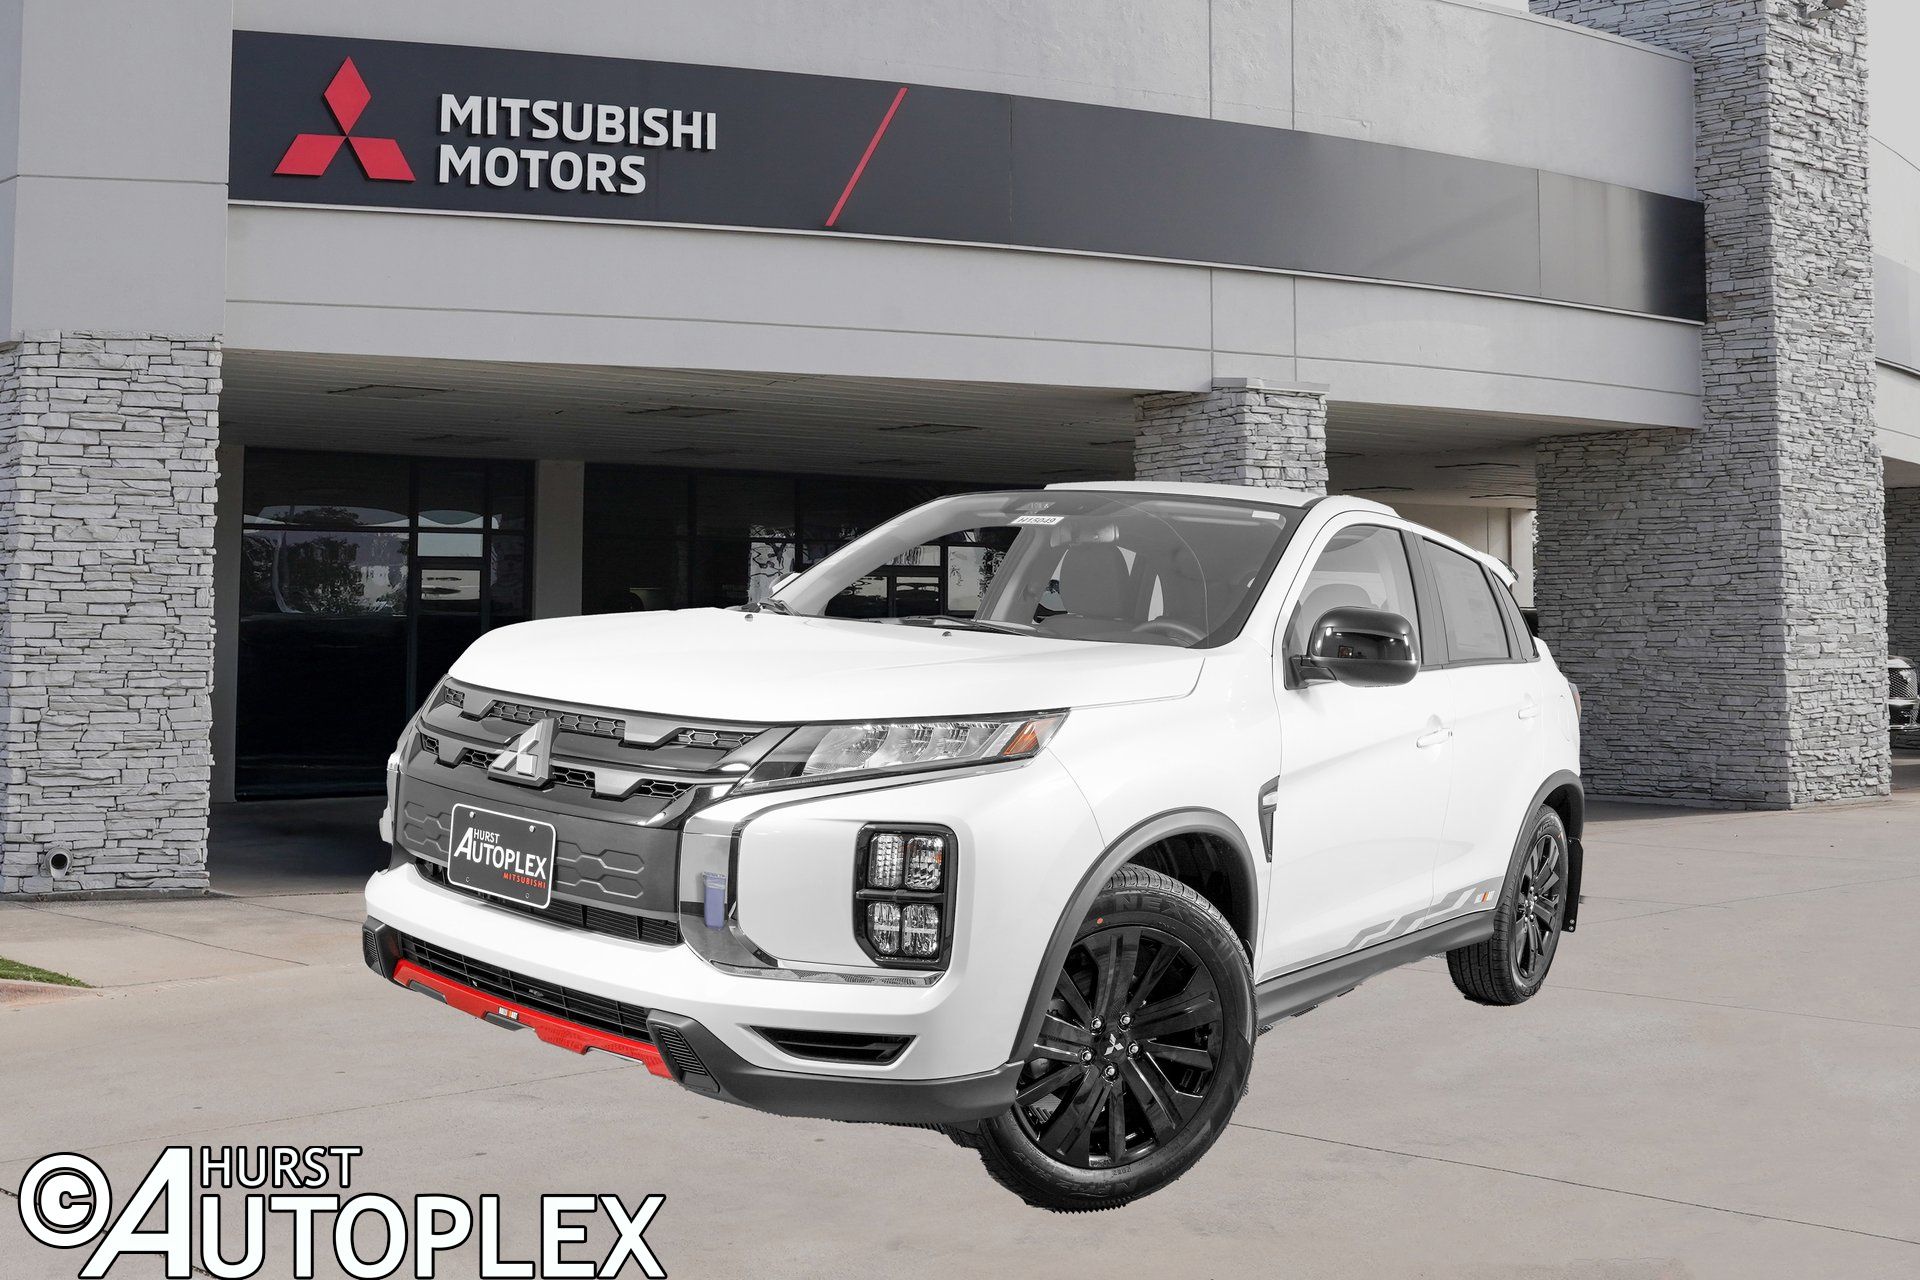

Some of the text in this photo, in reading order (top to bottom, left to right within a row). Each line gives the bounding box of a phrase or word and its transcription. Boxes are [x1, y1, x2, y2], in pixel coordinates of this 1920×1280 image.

[439, 93, 717, 151] MITSUBISHI
[438, 144, 647, 195] MOTORS
[453, 827, 547, 879] AUTOPLEX
[473, 828, 500, 844] HURST
[503, 872, 547, 889] MITSUBISHI
